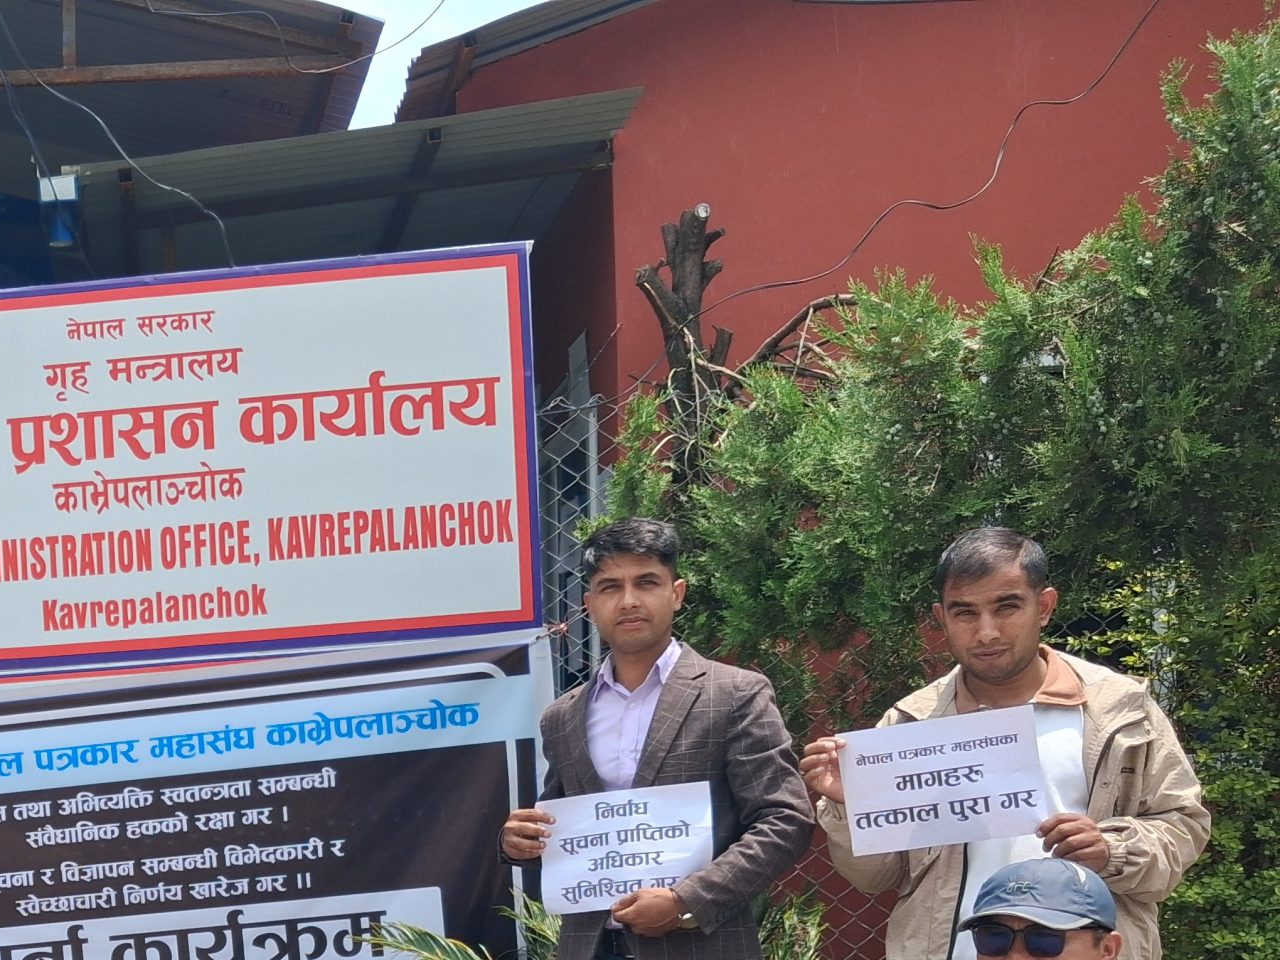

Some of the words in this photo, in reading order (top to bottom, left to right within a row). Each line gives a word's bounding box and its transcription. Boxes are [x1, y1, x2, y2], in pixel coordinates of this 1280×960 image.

[66, 318, 125, 341] नेपाल
[136, 310, 215, 337] सरकार
[42, 361, 92, 402] गृह
[106, 347, 244, 385] मन्त्रालय
[6, 400, 220, 475] प्रशासन
[238, 370, 500, 445] कार्यालय
[52, 461, 246, 515] काभ्रेपलाञ्चोक
[160, 519, 260, 570] OFFICE,
[267, 499, 514, 562] KAVREPALANCHOK
[42, 584, 267, 632] Kavrepalanchok
[33, 739, 140, 772] पत्रकार
[149, 724, 257, 760] महासंघ
[265, 699, 481, 746] काभ्रेपलाञ्चोक
[854, 752, 893, 767] नेपाल
[898, 744, 947, 760] पत्रकार
[950, 733, 1018, 754] महासंघका
[12, 801, 52, 821] तथा
[57, 787, 154, 816] अभिव्यक्ति
[160, 779, 251, 806] स्वतन्त्रता
[257, 766, 337, 796] सम्बन्धी
[894, 763, 984, 792] मागहरू
[125, 811, 188, 839] हकको
[194, 811, 235, 831] रक्षा
[241, 807, 273, 825] गर
[854, 803, 939, 830] तत्काल
[948, 796, 990, 822] पुरा
[999, 789, 1038, 810] गर
[559, 831, 610, 856] सूचना
[616, 820, 691, 846] प्राप्तिको
[40, 868, 55, 885] र
[60, 860, 135, 883] विज्ञापन
[141, 847, 218, 876] सम्बन्धी
[224, 837, 324, 867] विभेदकारी
[330, 839, 346, 857] र
[588, 850, 664, 872] अधिकार
[15, 887, 117, 917] स्वेच्छाचारी
[123, 882, 183, 906] निर्णय
[189, 876, 249, 900] खारेज
[255, 875, 287, 892] गर
[561, 877, 643, 905] सुनिश्चित
